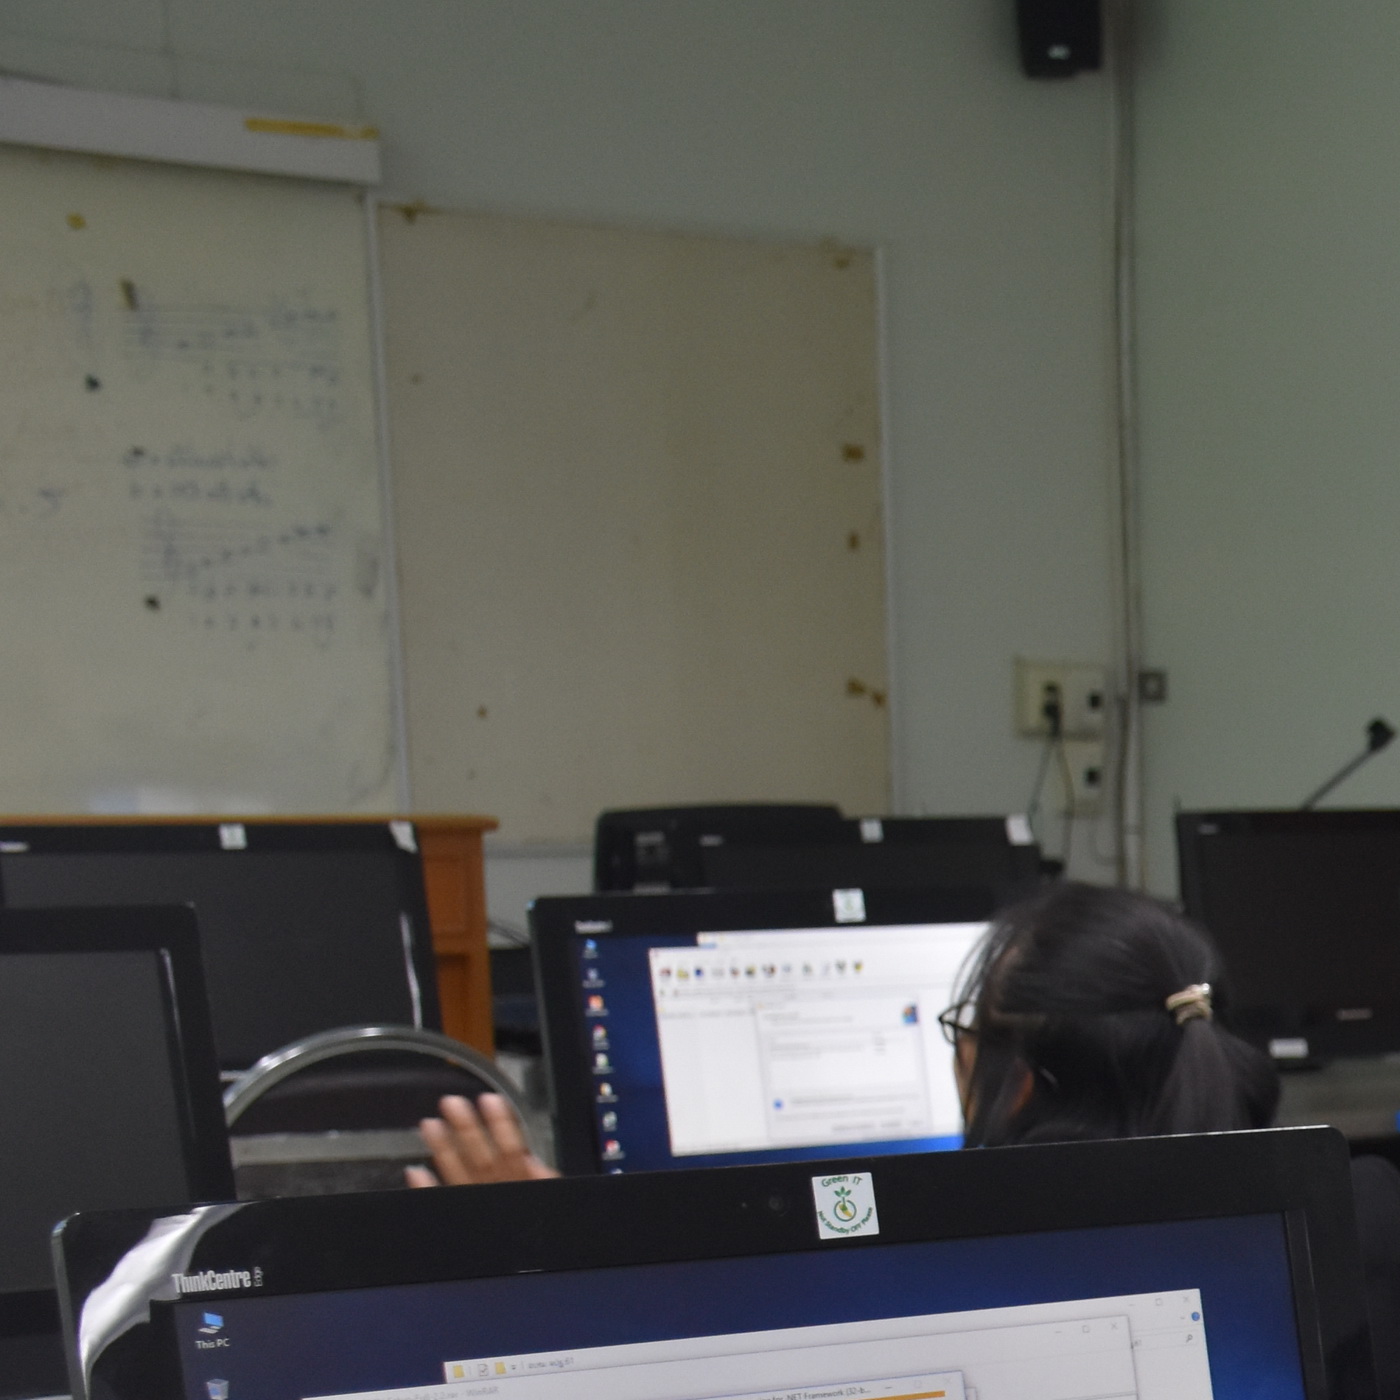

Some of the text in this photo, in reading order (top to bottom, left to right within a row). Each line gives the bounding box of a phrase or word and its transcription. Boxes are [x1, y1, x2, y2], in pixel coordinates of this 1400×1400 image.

[821, 1176, 862, 1187] Green IT
[172, 1269, 252, 1293] ThinkCentre
[196, 1338, 230, 1349] This PC
[804, 1389, 843, 1400] Framework
